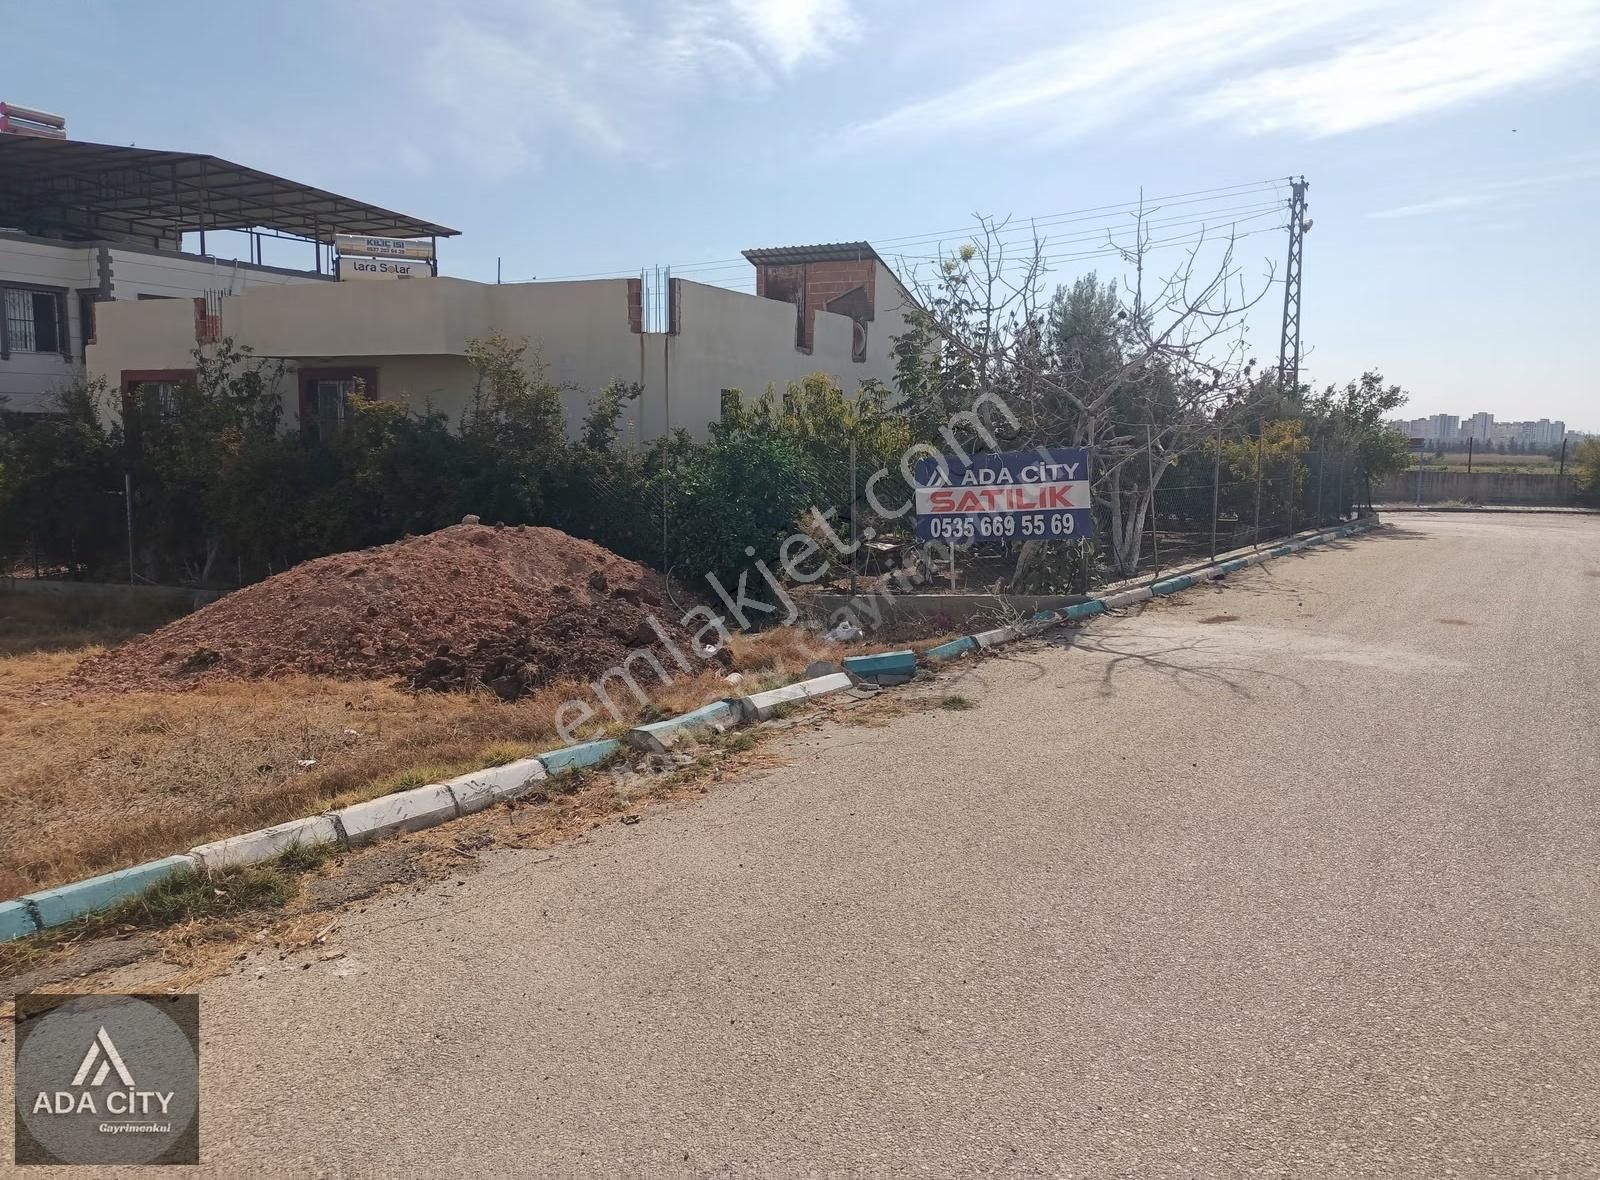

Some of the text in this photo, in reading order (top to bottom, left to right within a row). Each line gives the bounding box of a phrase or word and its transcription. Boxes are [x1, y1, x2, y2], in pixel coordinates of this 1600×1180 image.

[380, 263, 411, 274] Solar
[961, 467, 1014, 486] ADA
[929, 484, 1076, 513] SATILIK
[930, 513, 1075, 538] 0535 669 55 69
